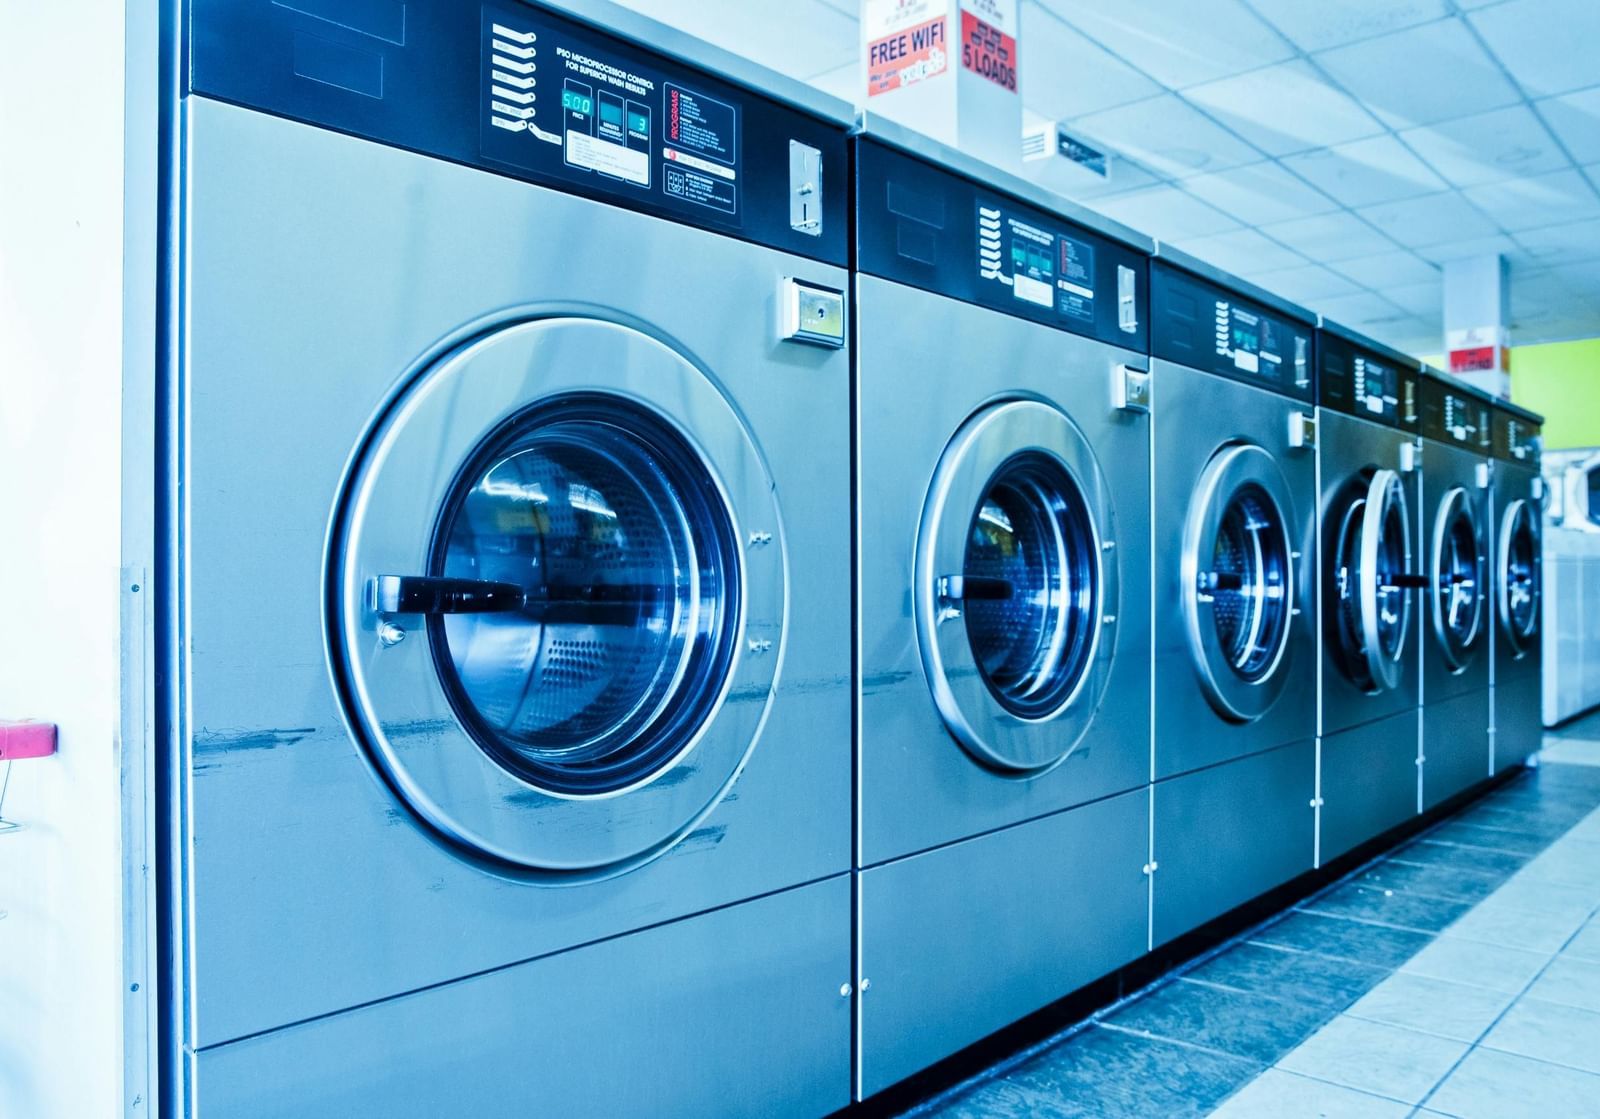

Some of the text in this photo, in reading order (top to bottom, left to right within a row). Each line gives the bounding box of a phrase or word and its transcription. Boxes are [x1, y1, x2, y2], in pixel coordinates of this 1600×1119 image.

[870, 35, 907, 67] FREE
[911, 21, 944, 52] WIFI
[565, 60, 646, 96] FOR SUPERIOR WASH RESULTS
[572, 52, 627, 80] MICROPROCESSOR
[627, 73, 655, 90] CONTROL
[963, 44, 971, 67] 5
[974, 48, 1016, 90] LOADS
[639, 118, 646, 131] 3
[671, 90, 679, 140] PROGRAMS
